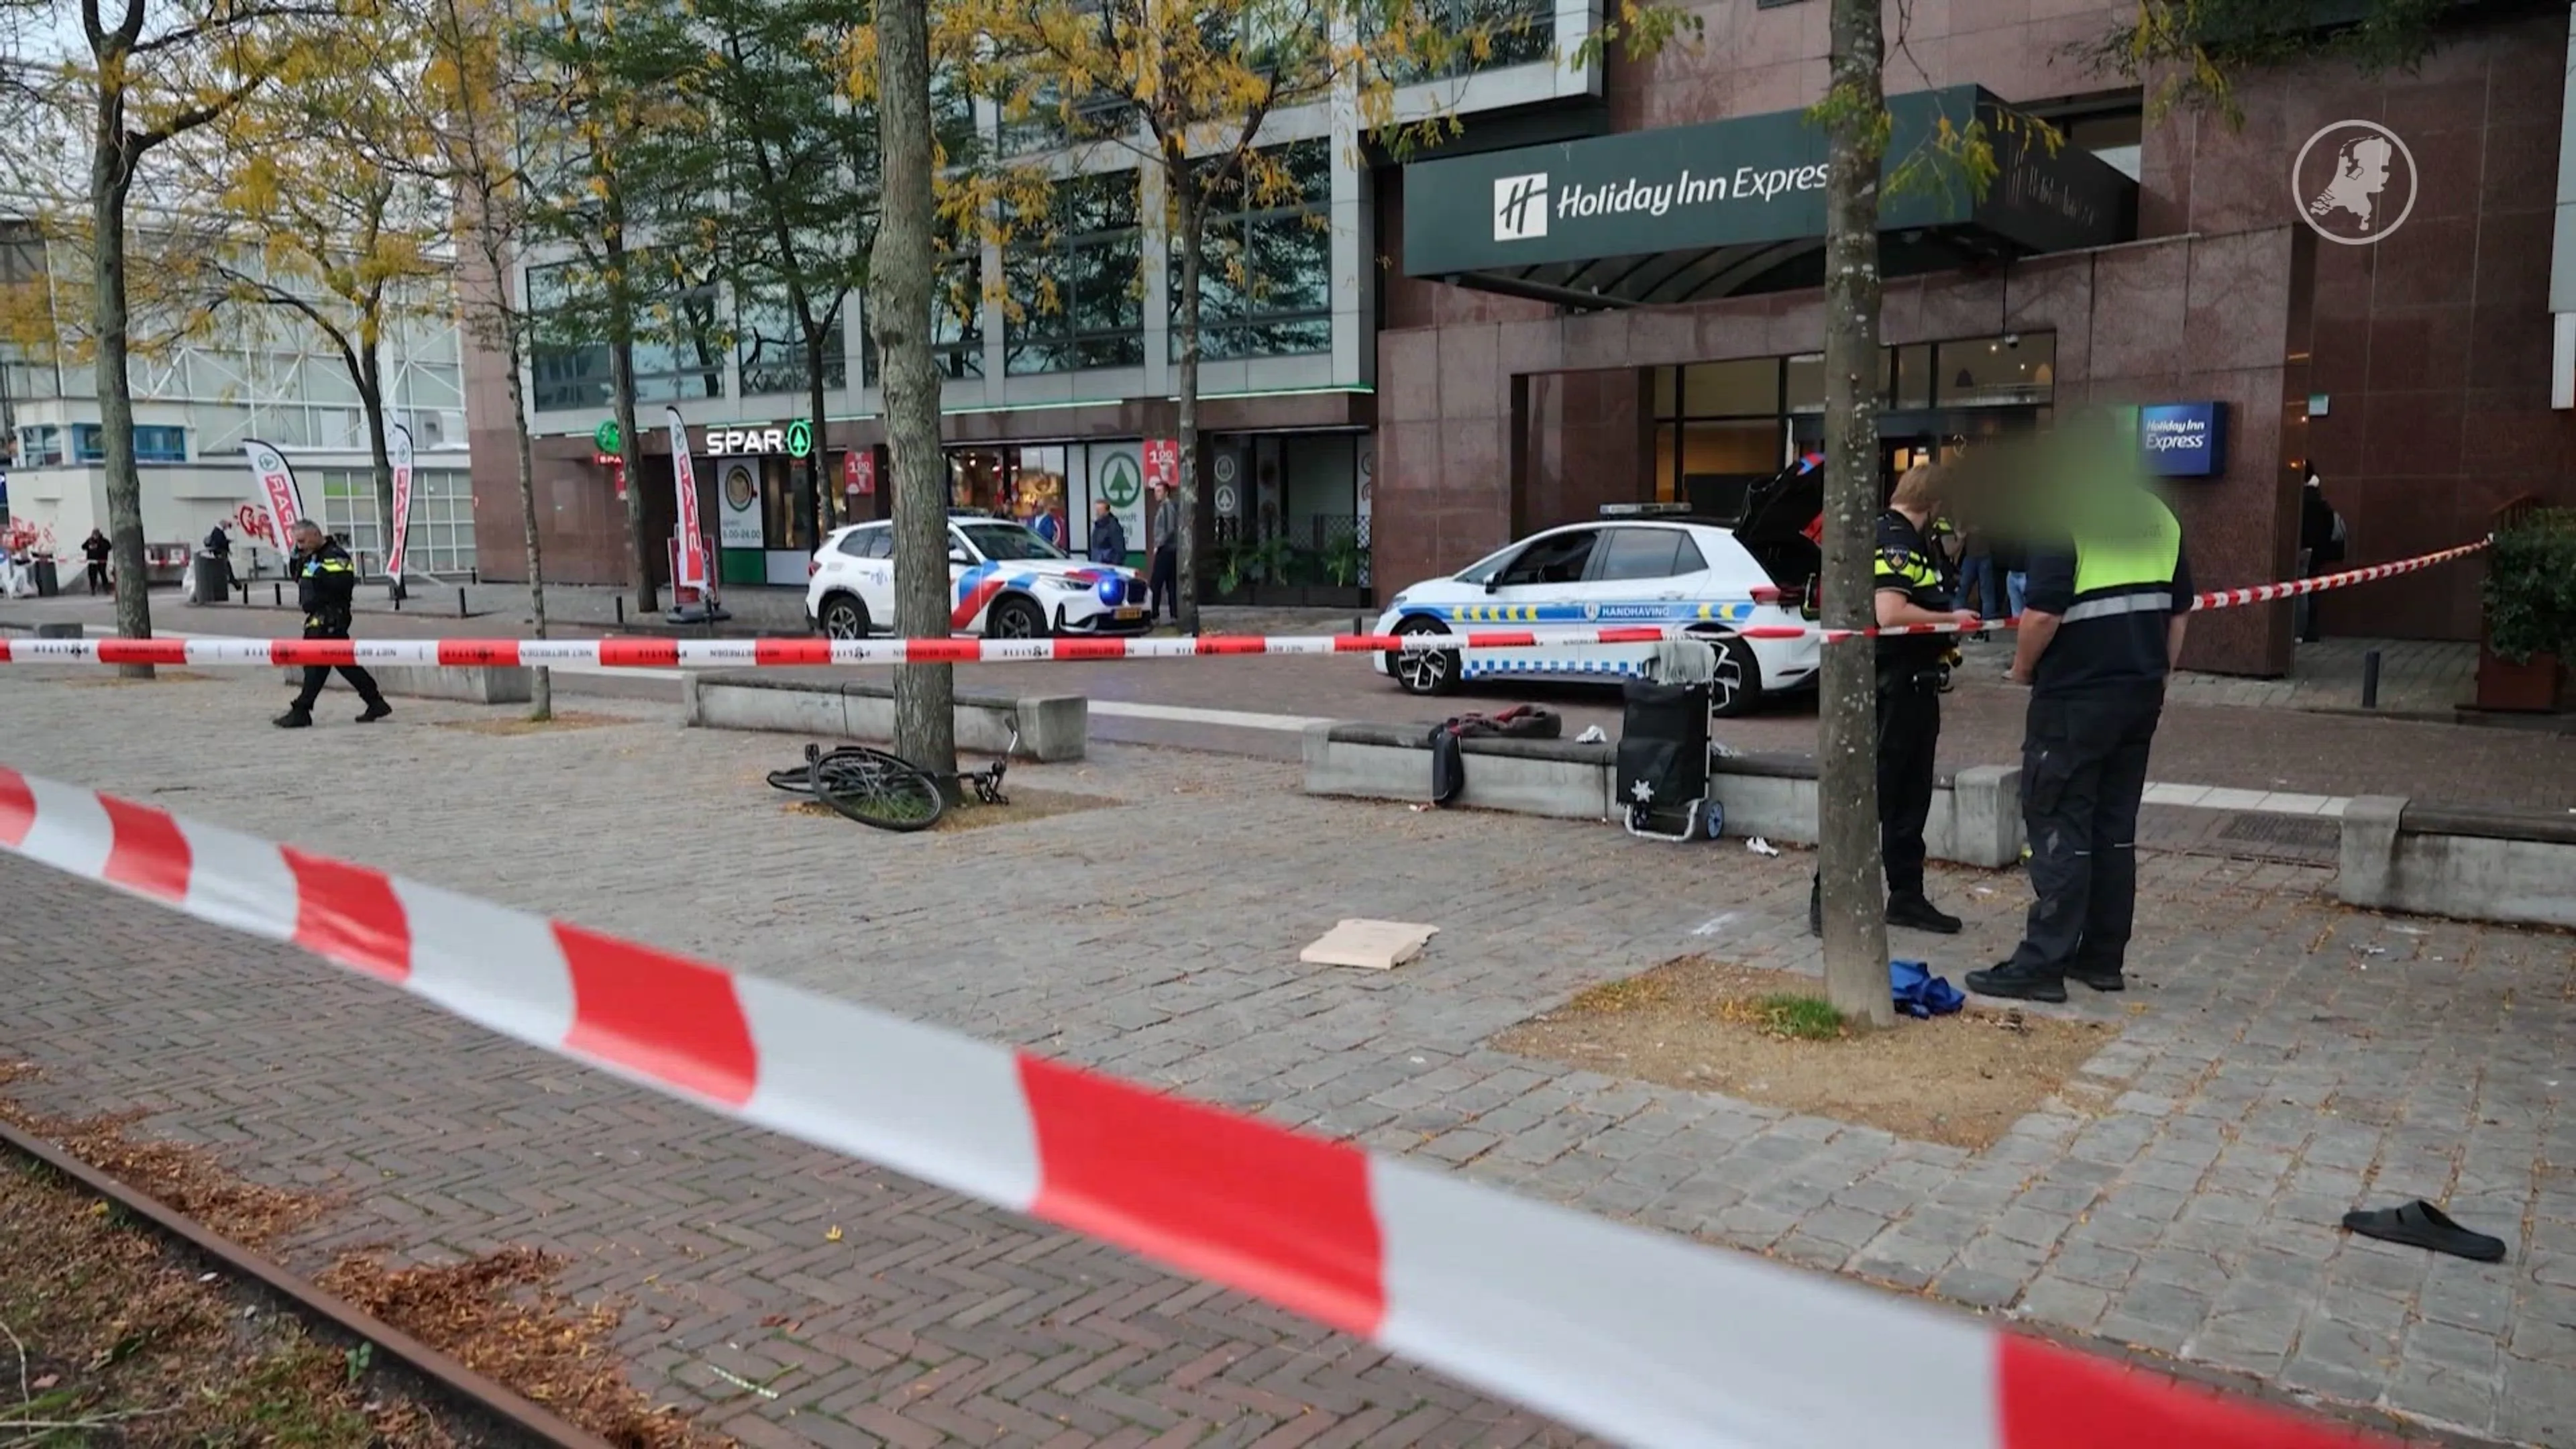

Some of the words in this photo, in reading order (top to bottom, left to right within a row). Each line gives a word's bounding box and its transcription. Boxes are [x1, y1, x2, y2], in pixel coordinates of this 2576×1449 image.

[1557, 177, 1673, 216] Holiday
[1677, 170, 1727, 205] Inn
[1732, 164, 1829, 201] Expres
[2147, 419, 2186, 433] Holiday
[2187, 419, 2205, 430] Inn
[706, 429, 784, 455] SPAR
[2146, 433, 2206, 452] Express
[599, 455, 622, 464] SPA
[1602, 606, 1670, 616] HANDHAVING
